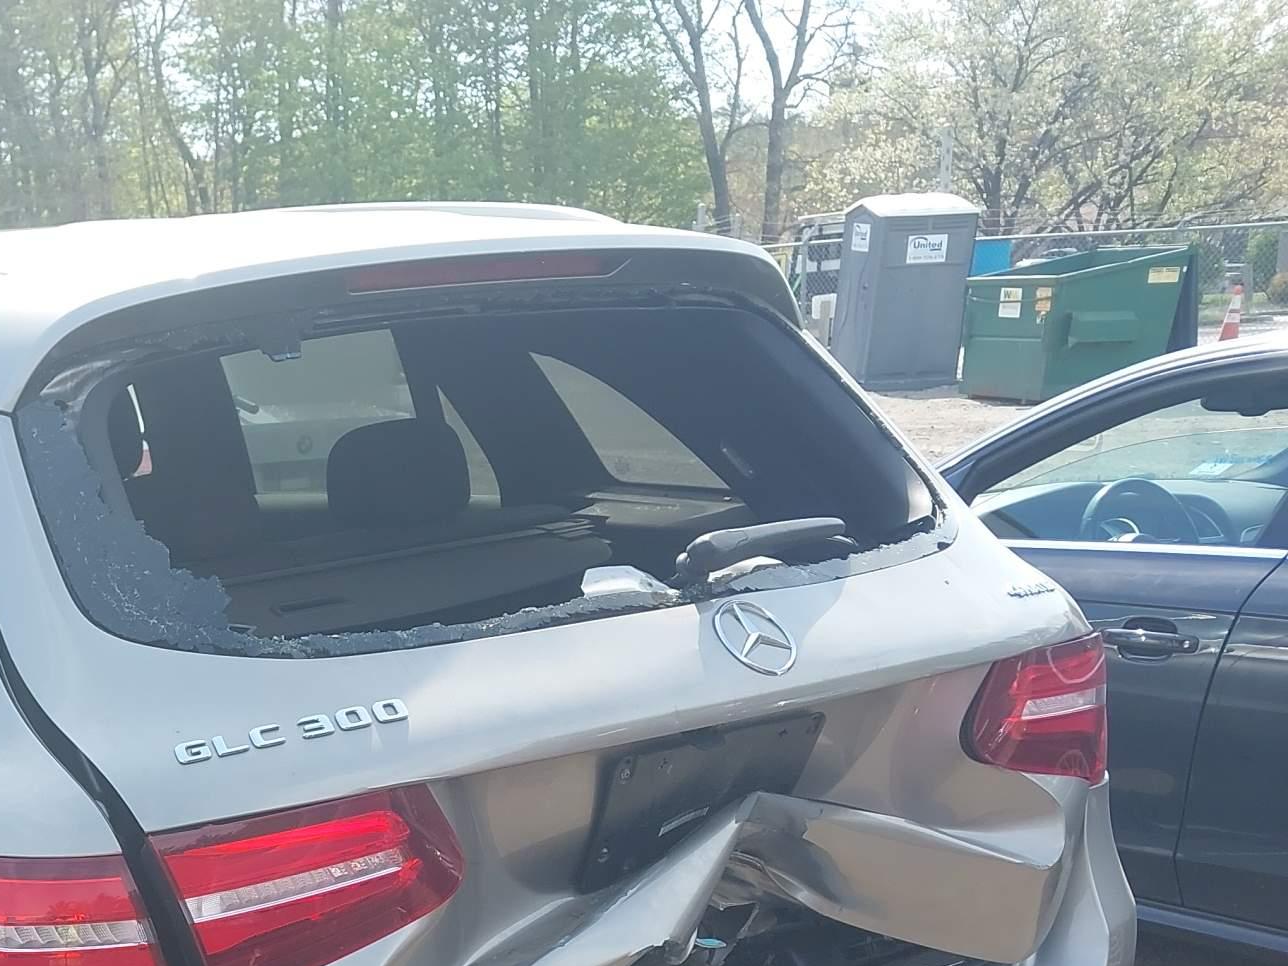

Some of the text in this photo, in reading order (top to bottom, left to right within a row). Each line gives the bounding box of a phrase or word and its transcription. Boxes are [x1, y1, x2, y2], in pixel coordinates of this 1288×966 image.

[913, 240, 943, 249] United
[173, 698, 410, 766] GLC 300
